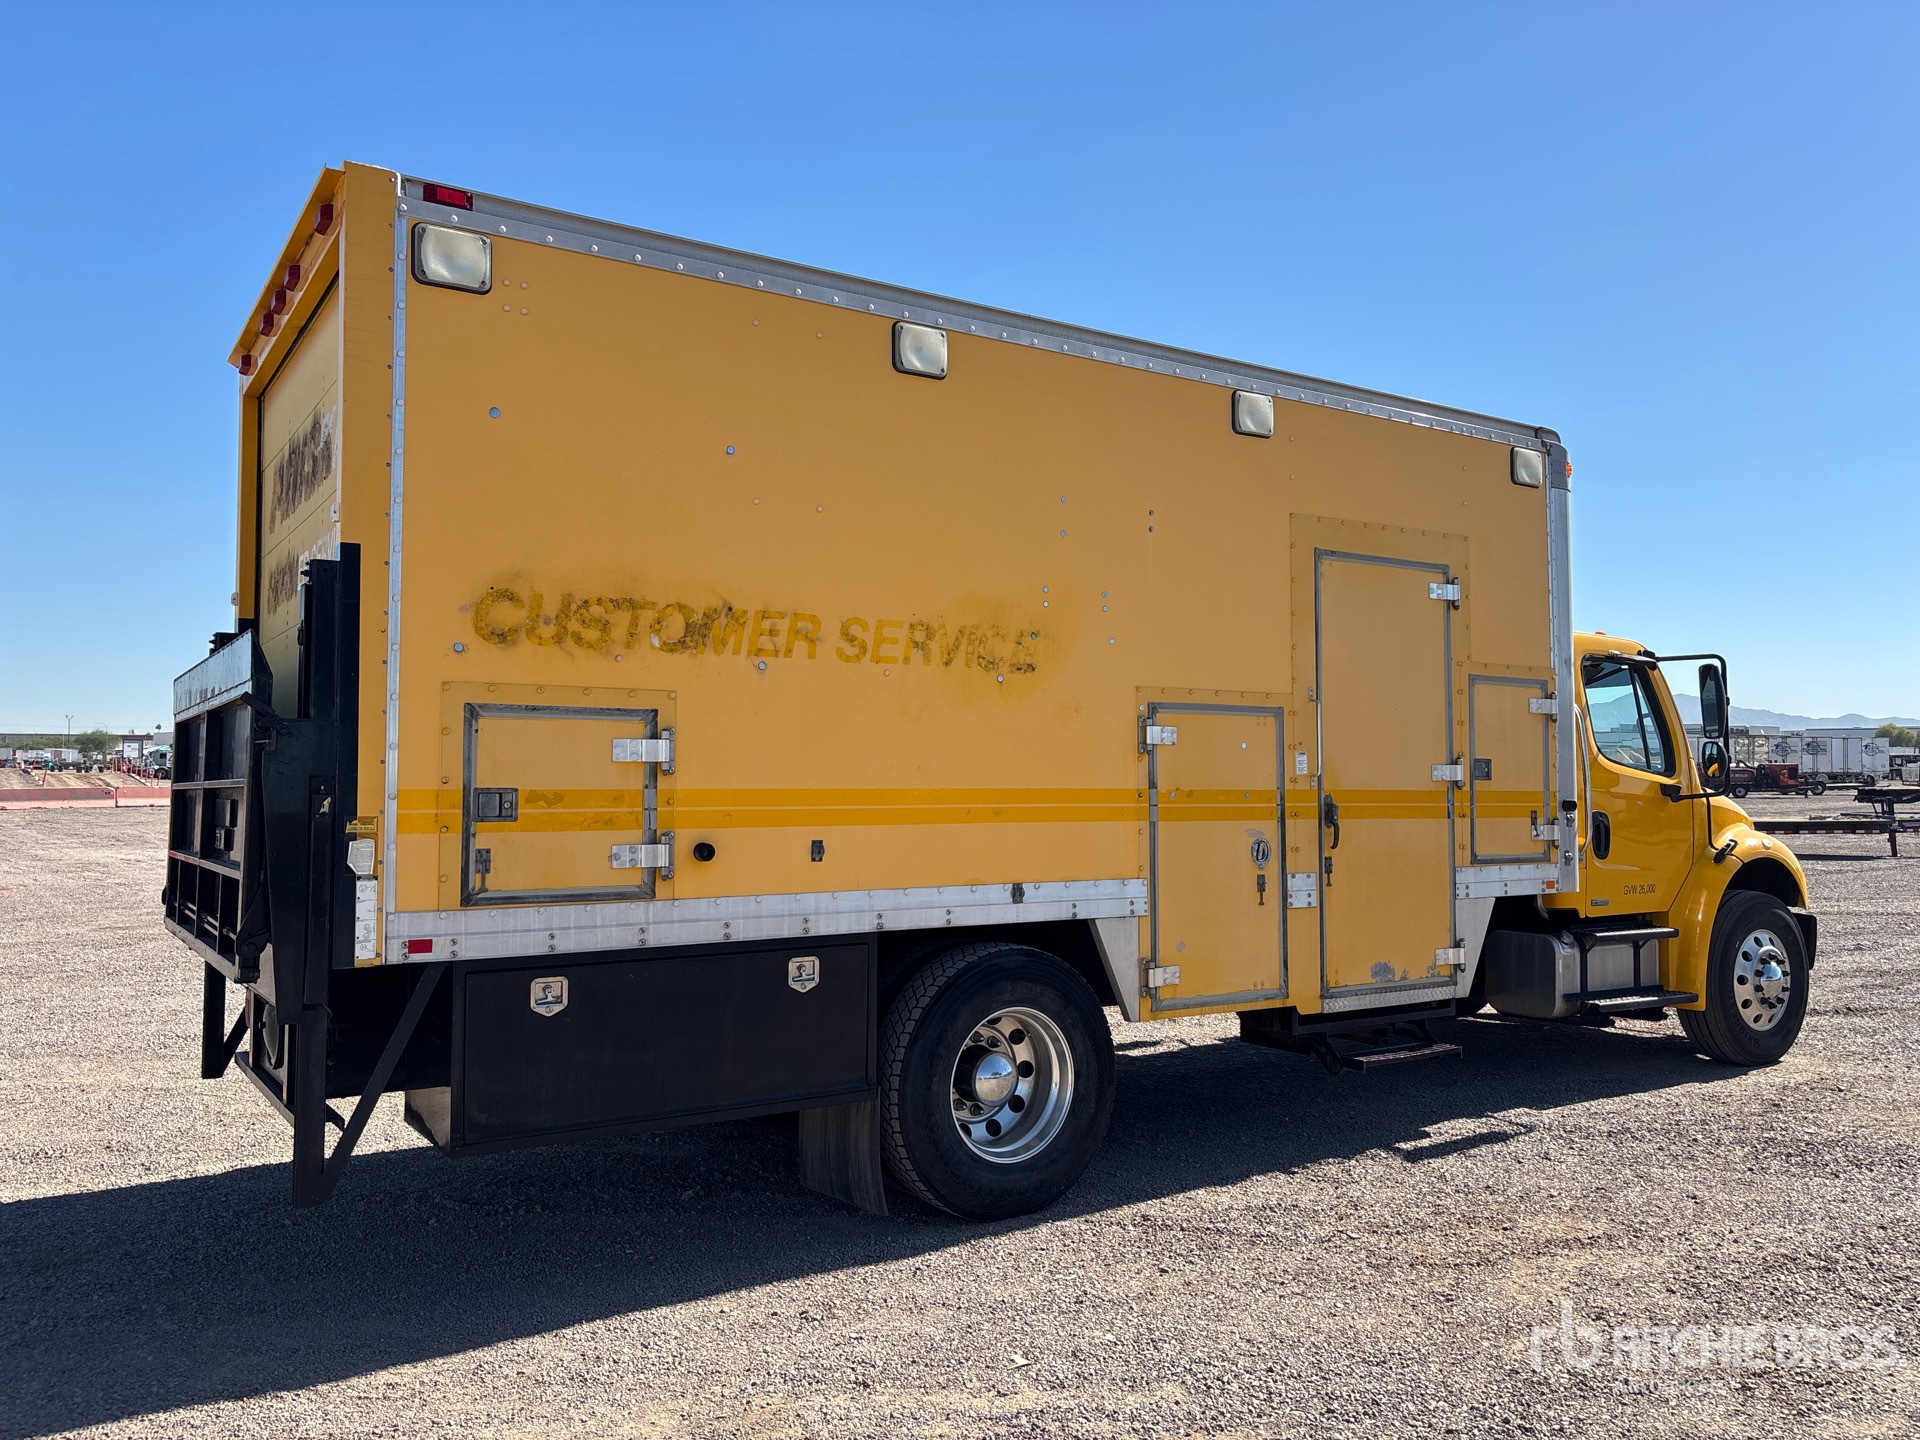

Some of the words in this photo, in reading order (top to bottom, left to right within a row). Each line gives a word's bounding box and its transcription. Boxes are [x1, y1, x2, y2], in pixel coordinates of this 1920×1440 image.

[472, 586, 823, 660] CUSTOMER
[835, 615, 1041, 674] SERVICE
[1624, 885, 1637, 895] GVW
[1639, 884, 1656, 895] 26,000
